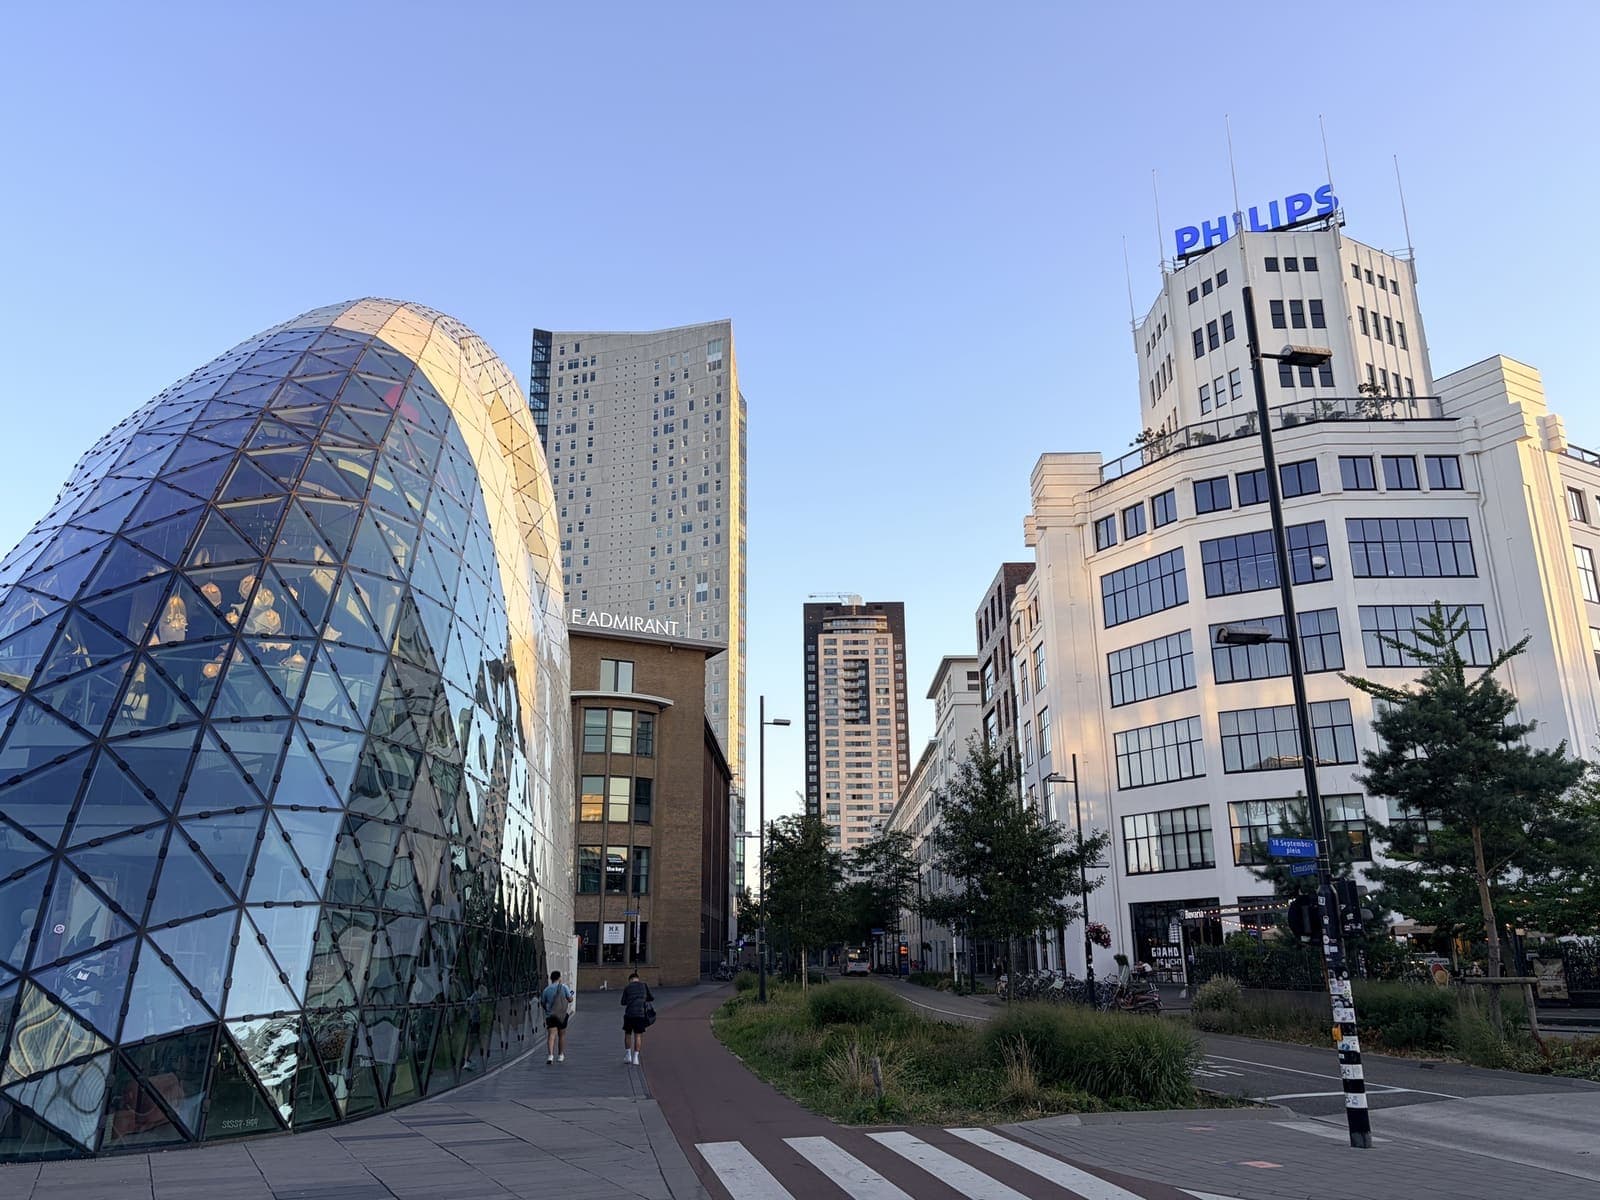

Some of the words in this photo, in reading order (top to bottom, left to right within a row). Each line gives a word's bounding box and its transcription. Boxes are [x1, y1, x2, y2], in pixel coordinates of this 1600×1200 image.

[586, 611, 679, 636] ADMIRANT
[1286, 847, 1302, 855] plein
[1151, 946, 1180, 957] GRAND
